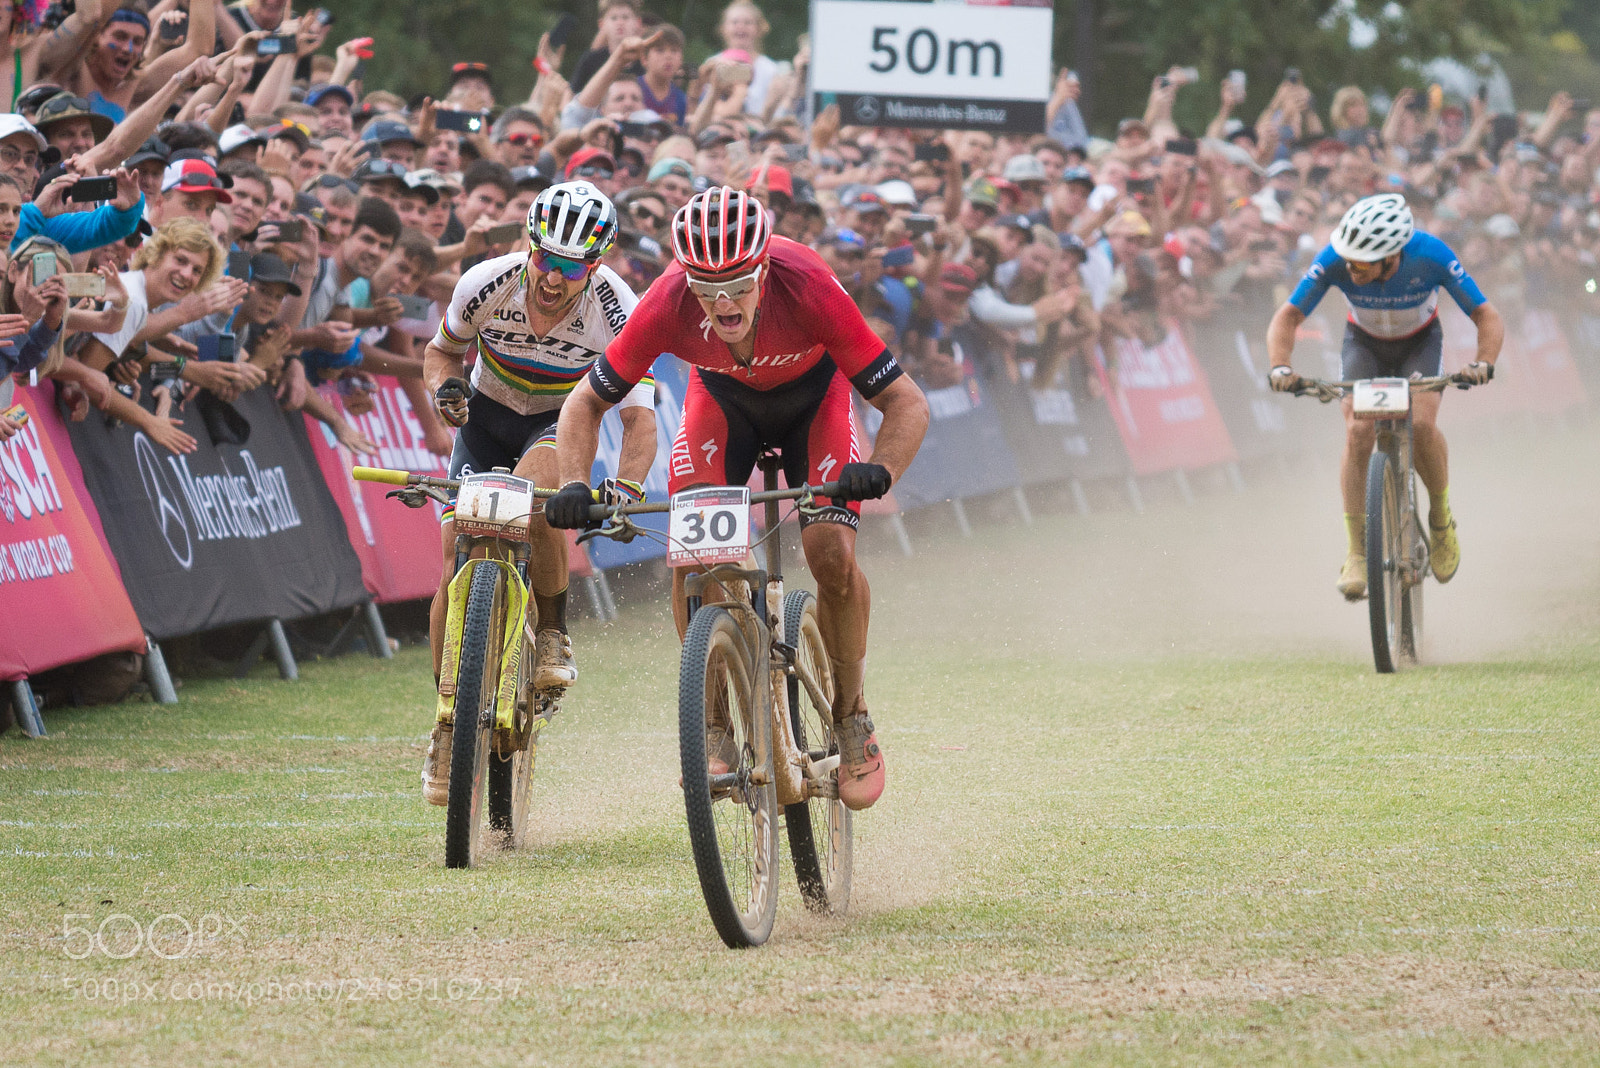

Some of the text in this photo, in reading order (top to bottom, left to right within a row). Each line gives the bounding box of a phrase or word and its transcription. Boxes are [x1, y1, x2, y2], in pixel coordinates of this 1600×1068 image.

[869, 26, 1004, 77] 50m
[885, 101, 1008, 123] Mercedes-Benz
[462, 263, 522, 325] SRAM
[500, 309, 527, 323] UCI
[1373, 391, 1389, 407] 2
[167, 449, 301, 541] Mercedes-Benz
[489, 491, 500, 521] 1
[679, 501, 693, 509] UCI
[681, 510, 737, 544] 30
[8, 538, 54, 582] WORLD
[47, 533, 75, 575] CUP
